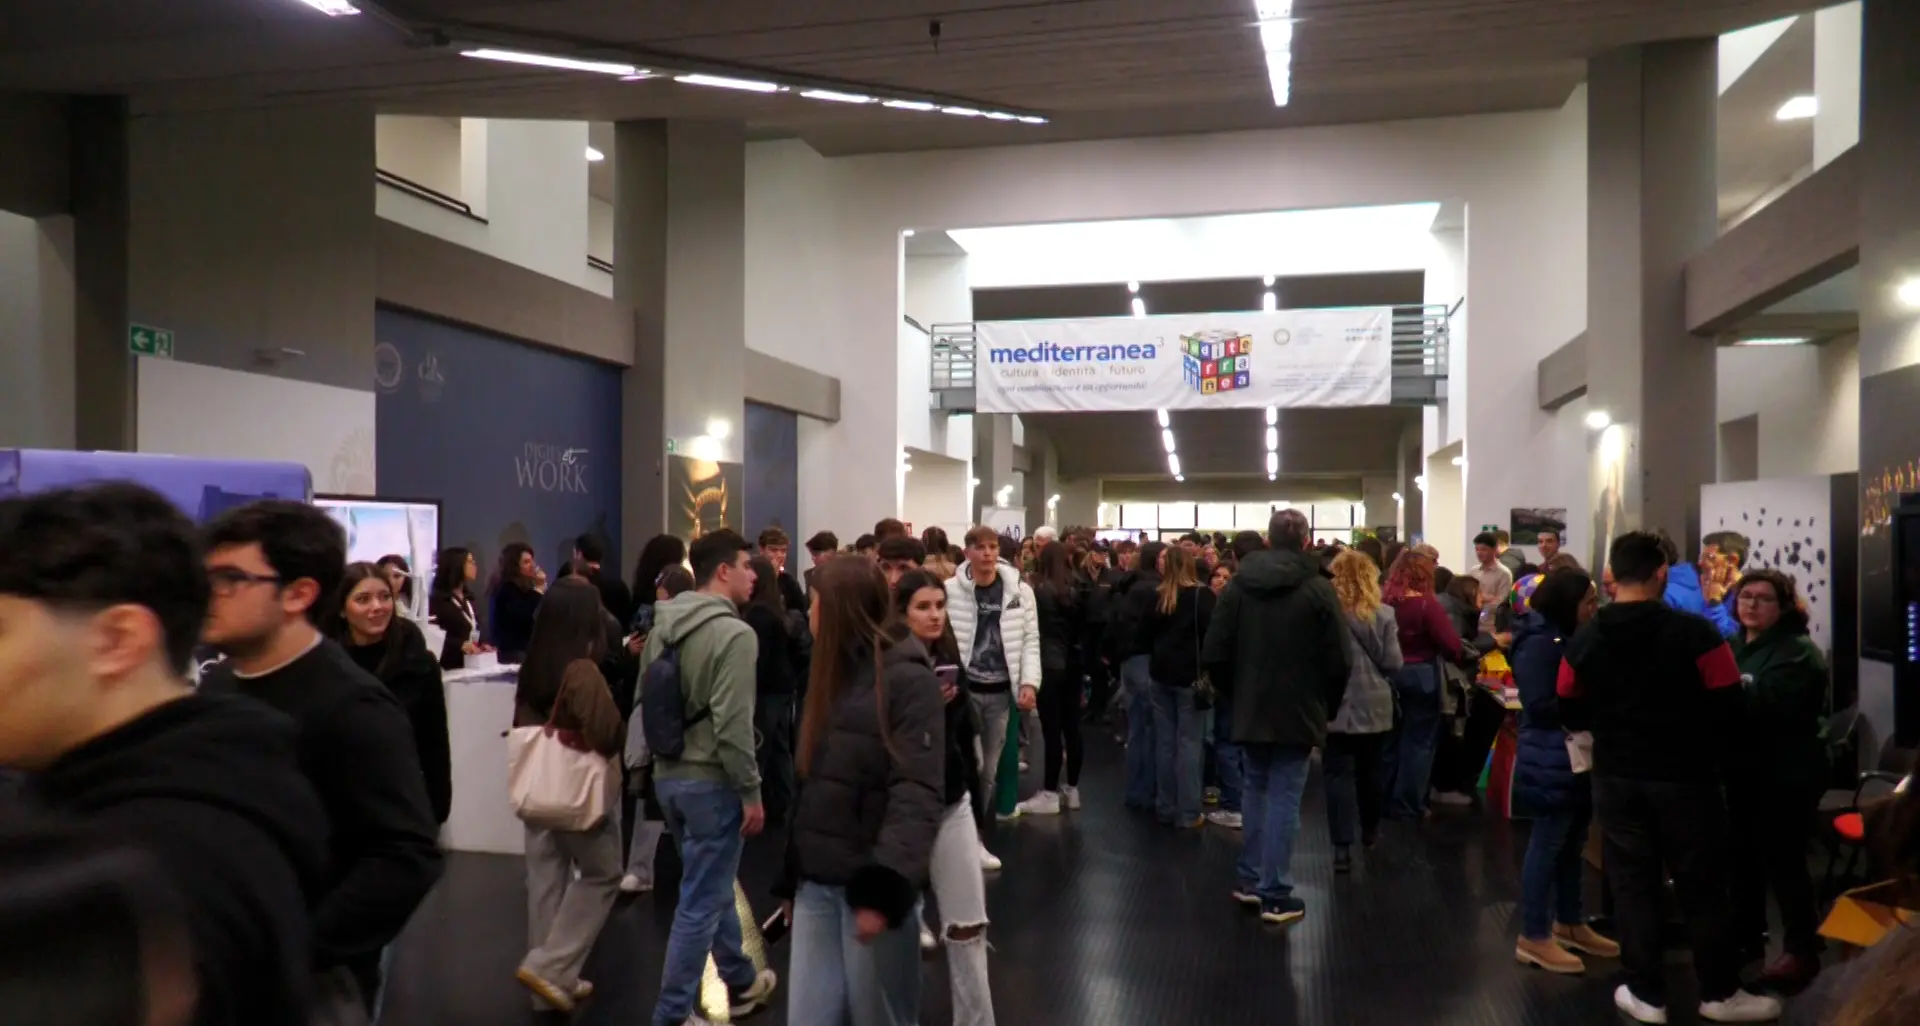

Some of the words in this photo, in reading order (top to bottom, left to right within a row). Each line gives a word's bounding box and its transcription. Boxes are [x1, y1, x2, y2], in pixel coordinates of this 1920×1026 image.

[990, 341, 1156, 363] mediterranea
[1001, 368, 1039, 378] cultura
[1109, 364, 1146, 376] futuro
[515, 455, 589, 493] WORK
